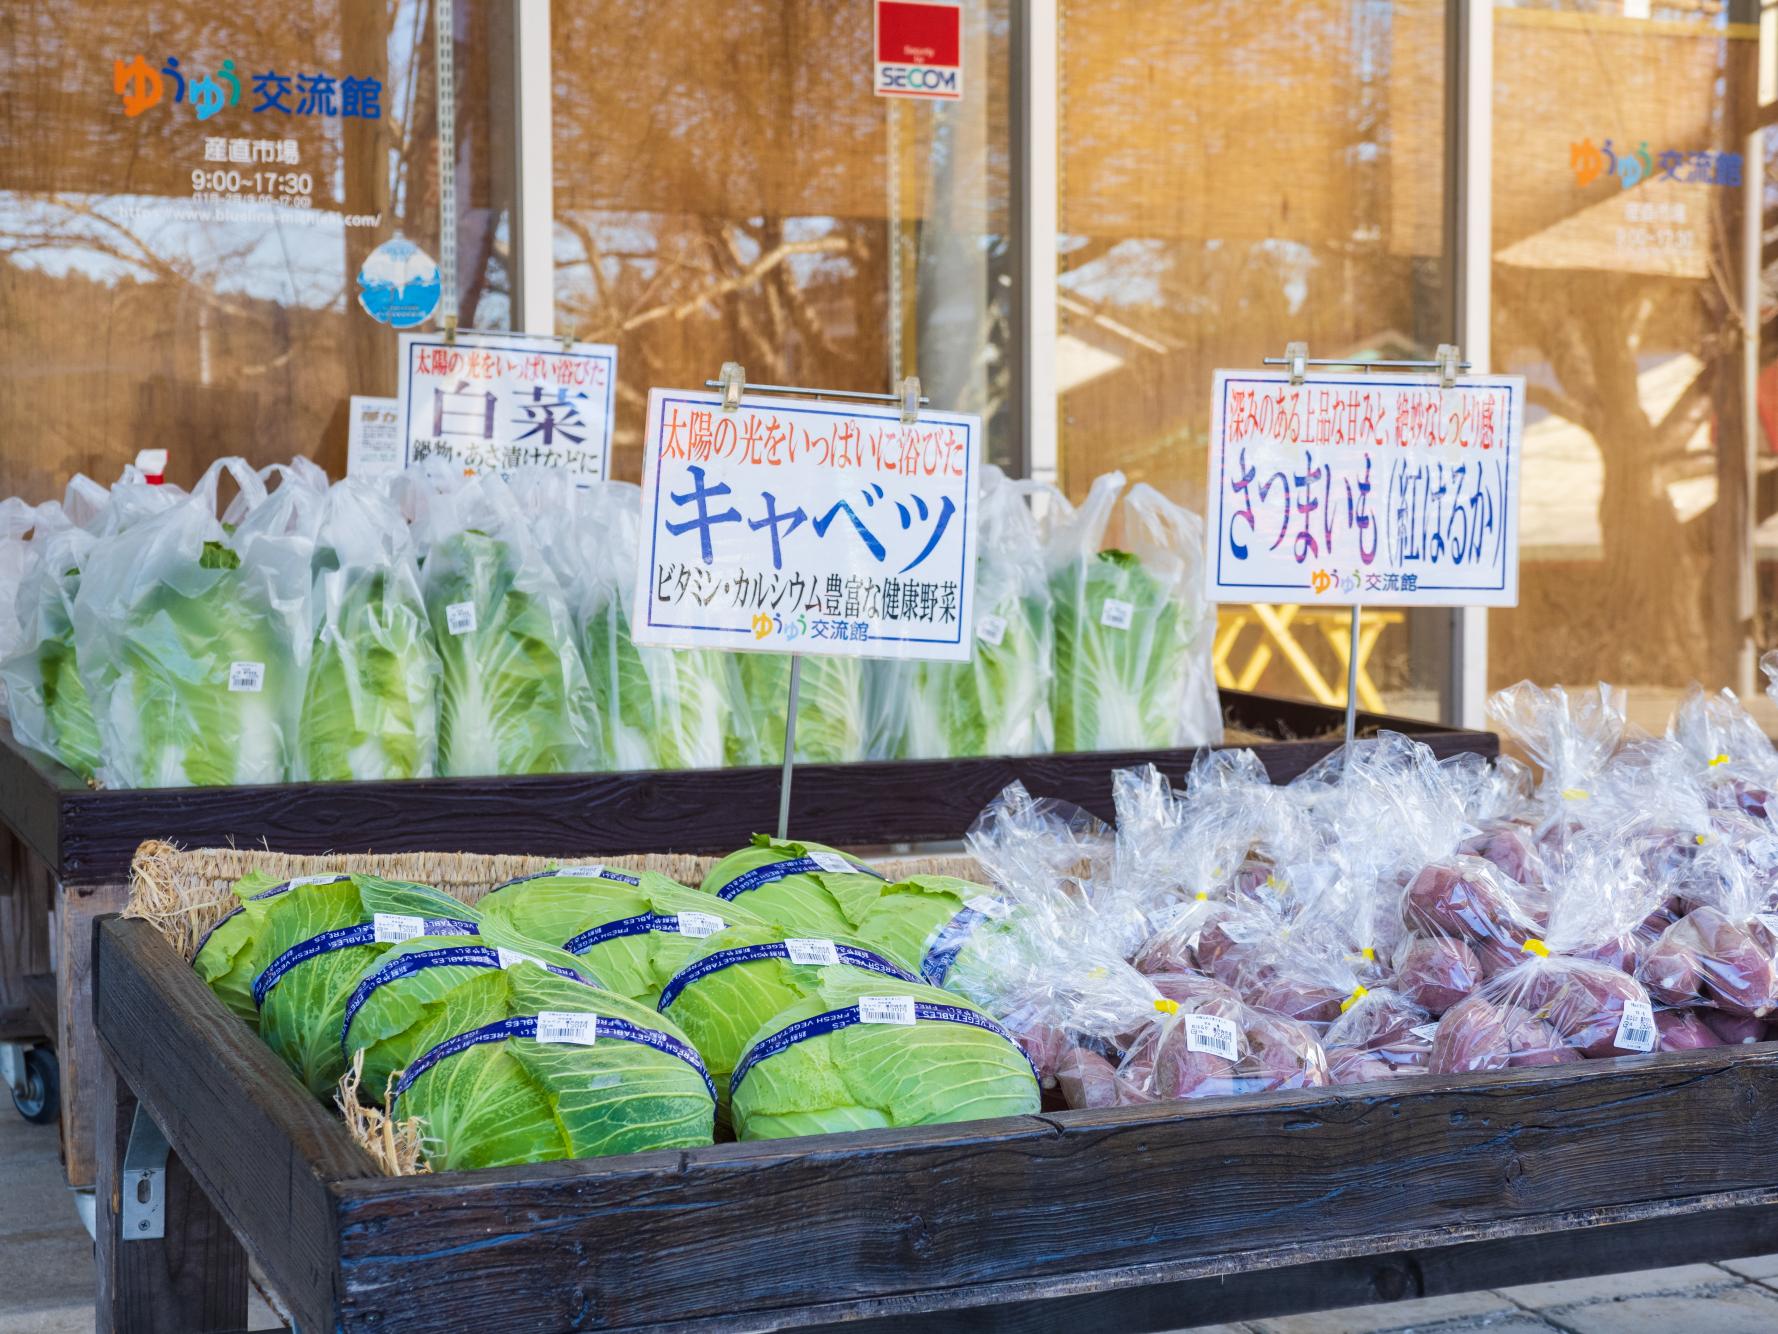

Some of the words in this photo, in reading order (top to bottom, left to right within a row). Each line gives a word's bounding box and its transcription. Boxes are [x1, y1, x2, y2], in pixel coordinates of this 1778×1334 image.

[113, 55, 382, 120] ゆうゆう交流館
[882, 67, 956, 90] SECOM
[205, 137, 300, 165] 産直市場
[416, 347, 605, 387] 太陽の光をいっぱい浴びた
[433, 380, 589, 445] 白菜
[660, 408, 964, 477] 太陽の光をいっぱいに浴びた
[665, 465, 956, 574] キャベツ
[657, 562, 957, 624] ビタミン・カルシウム豊富な健康野菜
[1312, 569, 1418, 593] ゆうゆう交流館
[751, 613, 868, 642] ゆうゆう交流館
[414, 949, 447, 959] FRESH
[816, 1012, 850, 1023] FRESH
[922, 1011, 986, 1027] VEGETABLES
[754, 1020, 814, 1052] VEGETABLES
